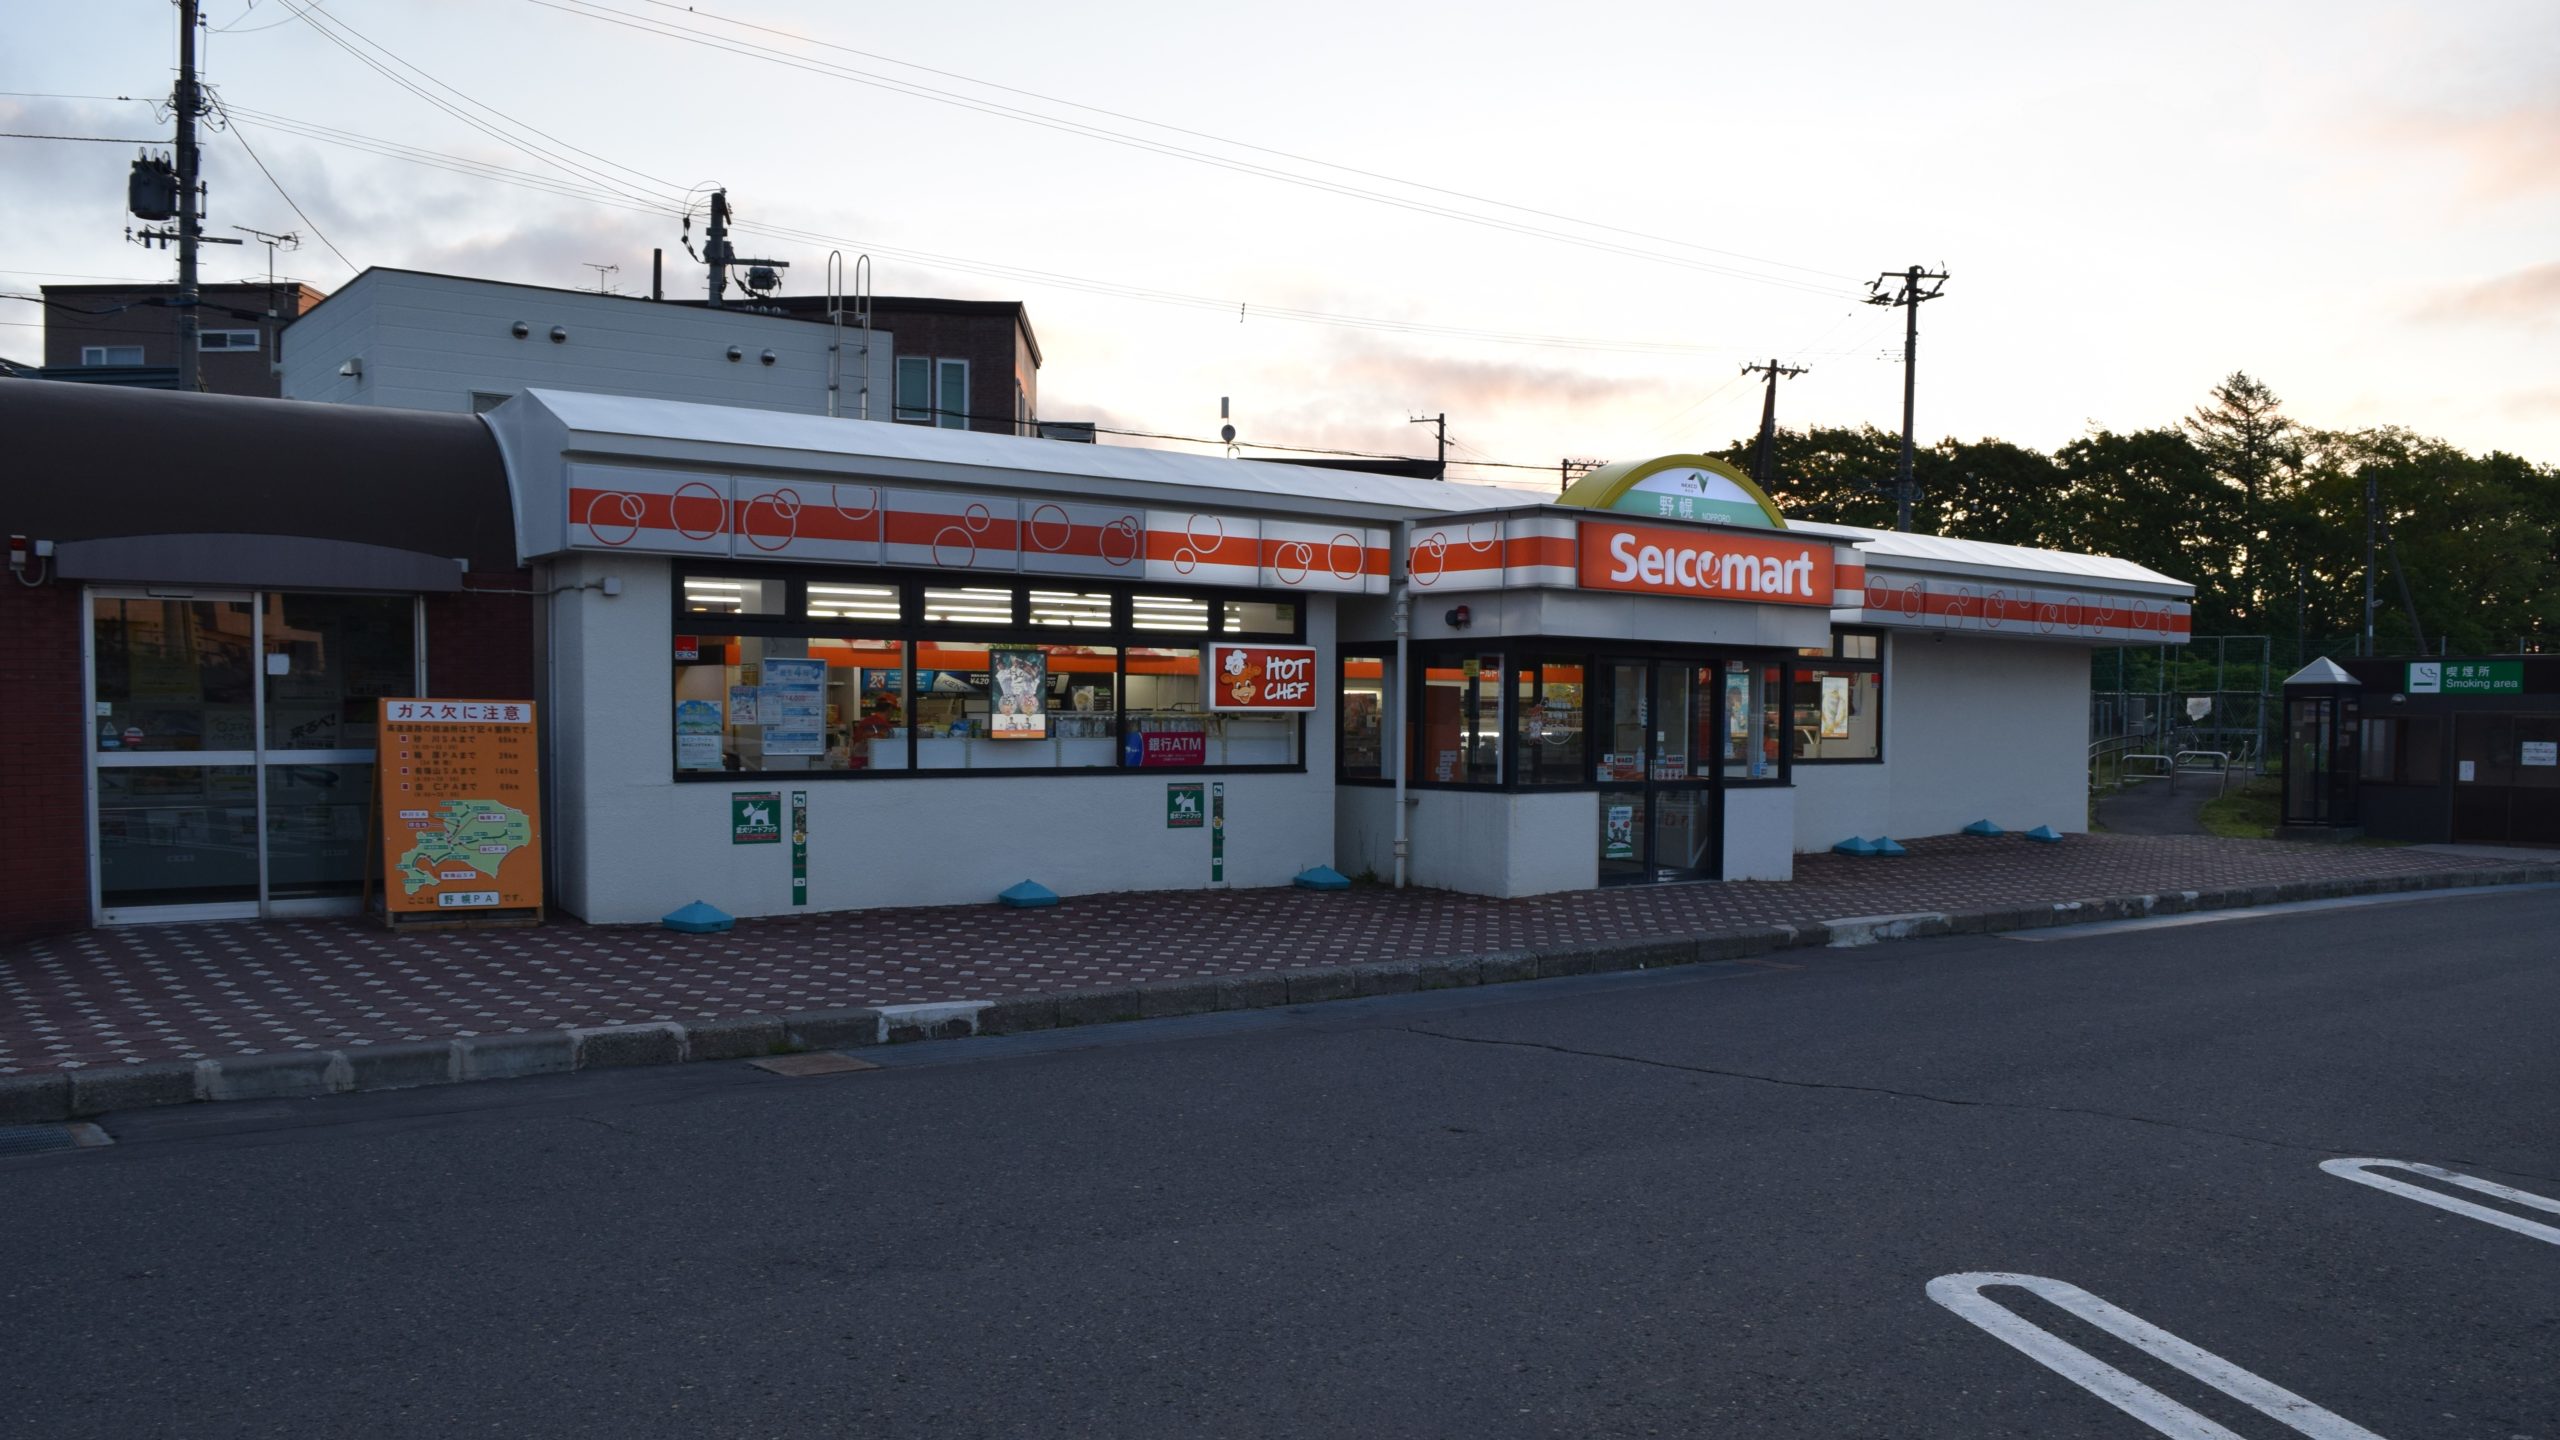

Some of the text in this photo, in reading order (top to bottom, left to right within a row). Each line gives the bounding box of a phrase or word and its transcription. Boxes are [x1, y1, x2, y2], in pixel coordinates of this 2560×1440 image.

[1702, 512, 1731, 523] NOPPORO
[1610, 532, 1814, 597] Seicomart
[1265, 656, 1312, 680] HOT
[2446, 666, 2490, 677] 喫煙所
[1264, 682, 1310, 700] CHEF
[2446, 678, 2518, 689] Smoking area
[398, 704, 520, 720] ガス欠に注意
[1149, 737, 1201, 751] 銀行ATM
